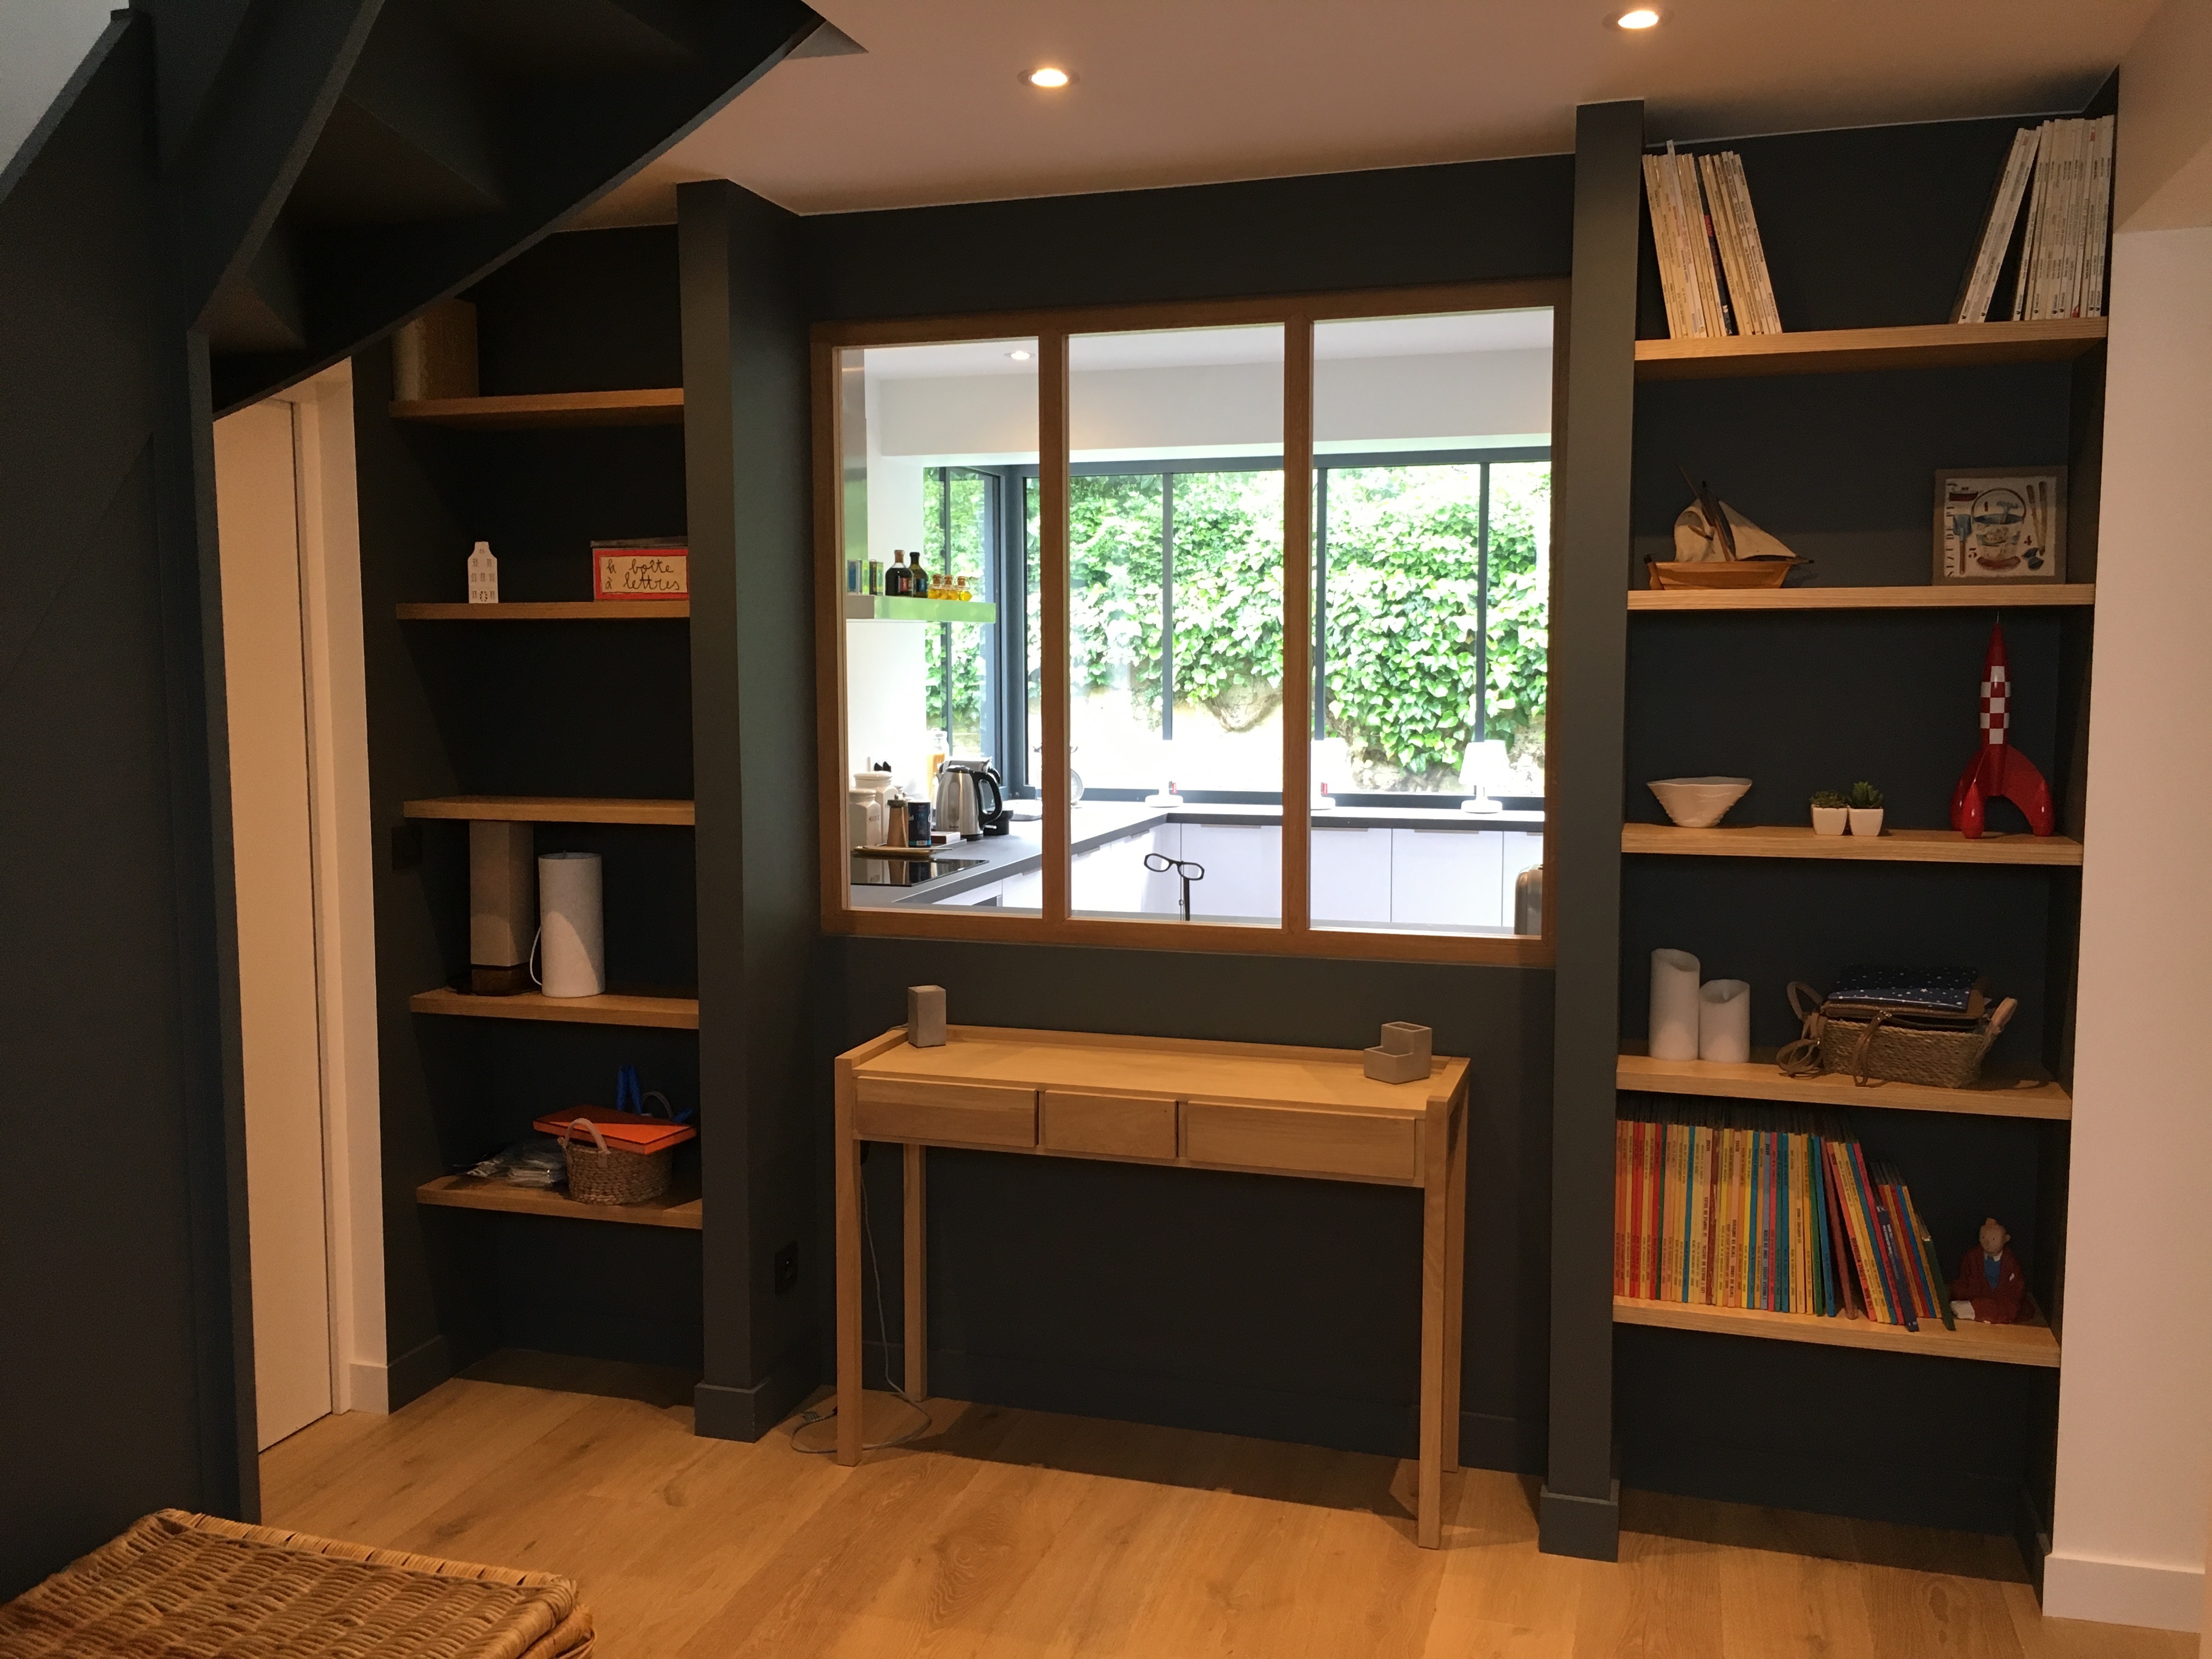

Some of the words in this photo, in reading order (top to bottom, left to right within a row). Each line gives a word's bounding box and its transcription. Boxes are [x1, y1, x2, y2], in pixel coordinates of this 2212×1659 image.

[629, 558, 674, 574] boîte
[605, 577, 612, 590] à
[623, 572, 680, 591] lettres
